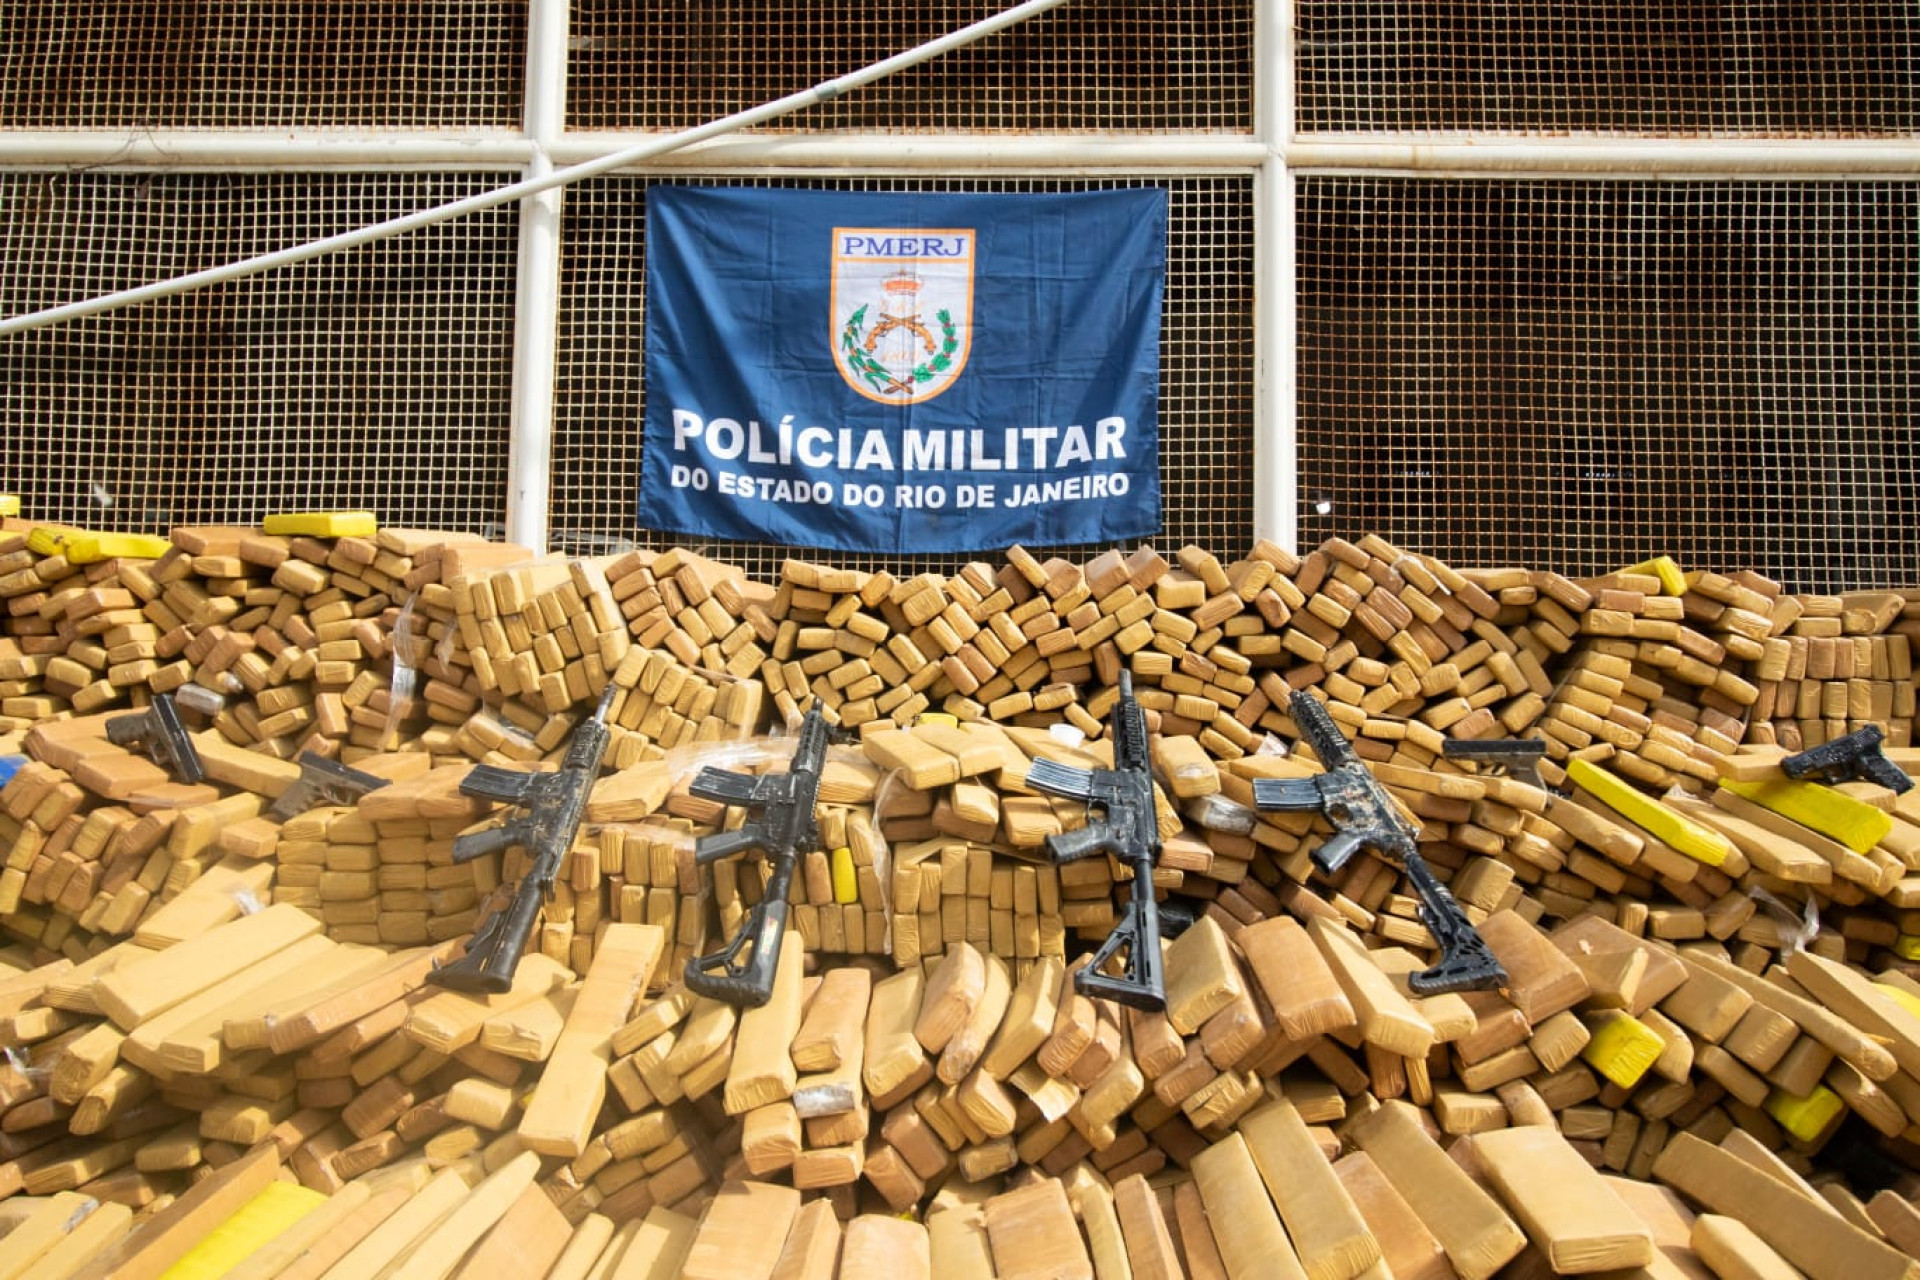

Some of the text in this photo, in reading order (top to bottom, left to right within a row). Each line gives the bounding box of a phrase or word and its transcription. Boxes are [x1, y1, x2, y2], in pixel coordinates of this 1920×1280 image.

[843, 236, 965, 257] PMERJ
[672, 409, 1127, 471] POLÍCIA MILITAR
[671, 465, 1129, 509] DO ESTADO DO RIO DE JANEIRO
